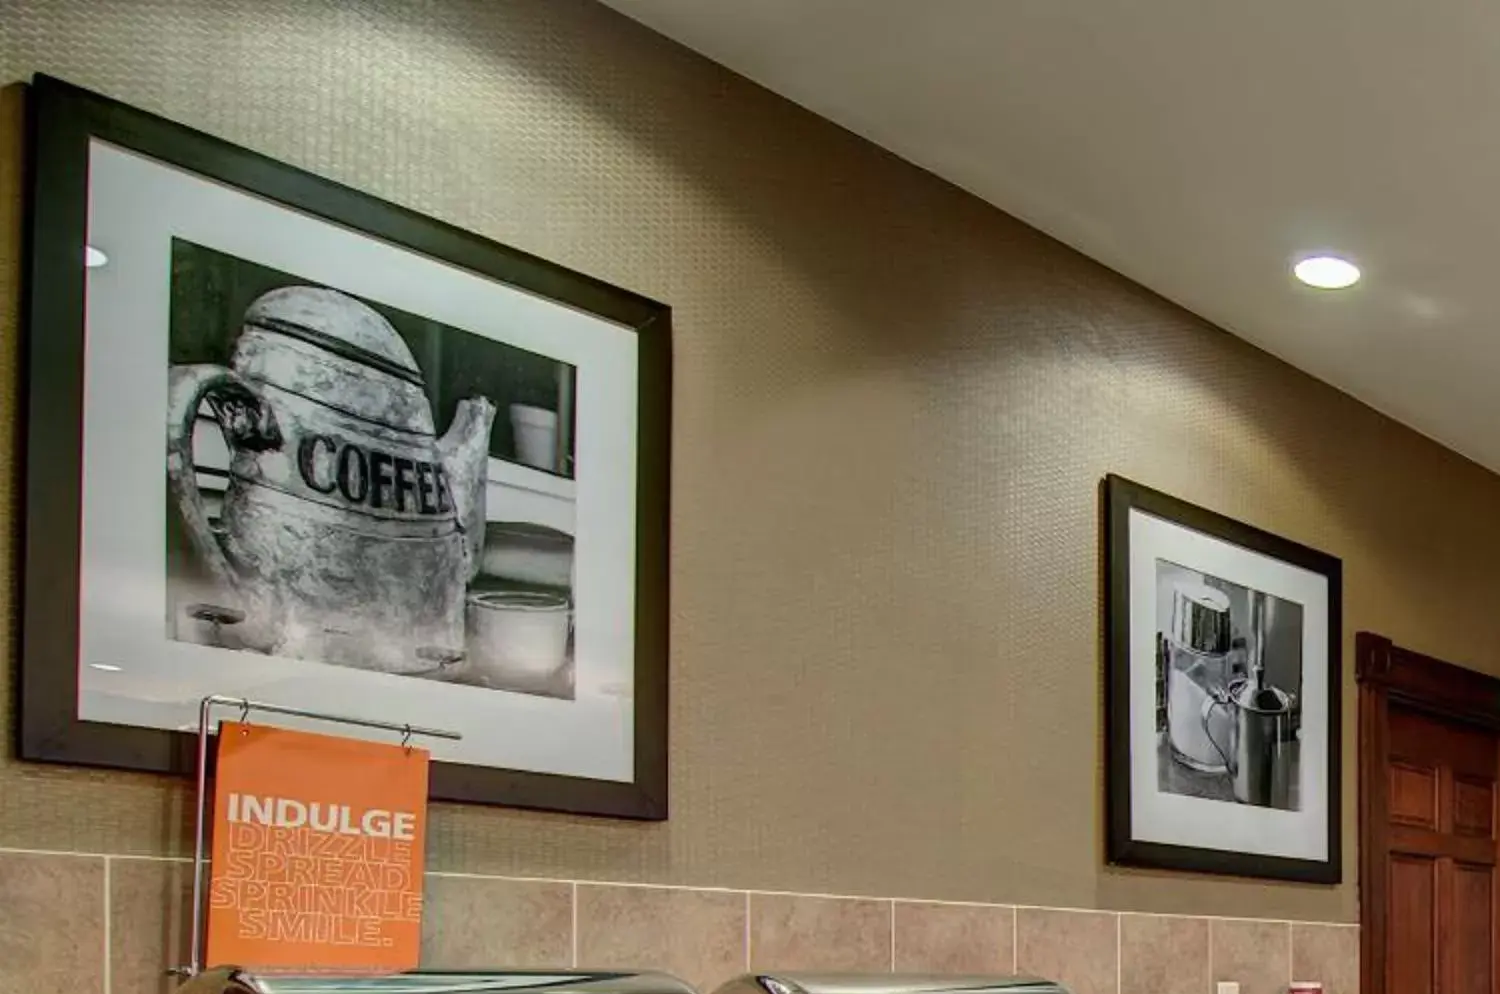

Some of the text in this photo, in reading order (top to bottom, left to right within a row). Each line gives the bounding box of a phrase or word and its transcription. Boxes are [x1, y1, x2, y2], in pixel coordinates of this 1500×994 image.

[227, 793, 416, 841] INDULGE
[229, 822, 412, 868] DRIZZLE
[226, 850, 411, 893] SPREAD
[210, 876, 424, 923] SPRINKLE
[238, 907, 394, 947] SMILE.
